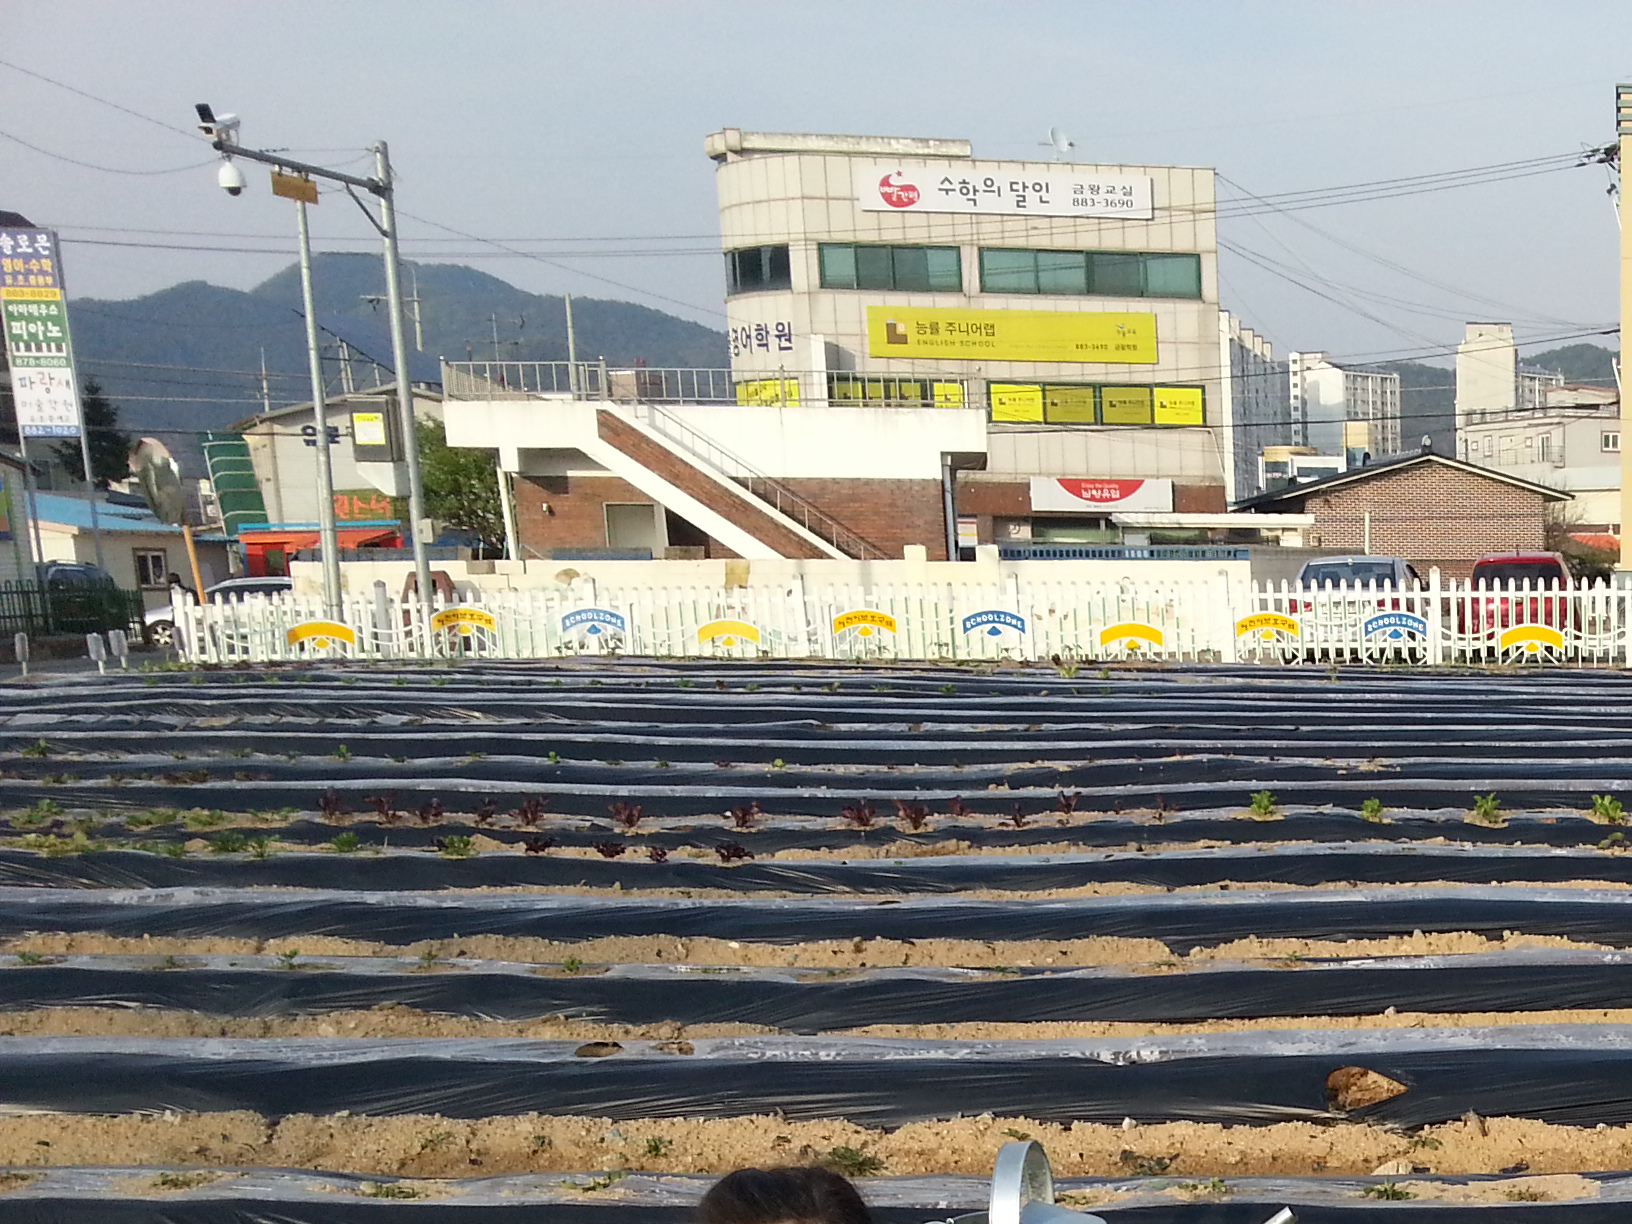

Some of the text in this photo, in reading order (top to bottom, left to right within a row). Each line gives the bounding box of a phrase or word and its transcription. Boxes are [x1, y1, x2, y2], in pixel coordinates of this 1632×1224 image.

[938, 176, 1050, 209] 수학의 달인
[1072, 183, 1134, 197] 금왕교실
[1072, 198, 1134, 209] 883-3690
[0, 233, 51, 255] 솔로몬
[10, 320, 63, 340] 피아노
[915, 321, 996, 337] 능률 주니어랩
[917, 339, 996, 348] ENGLISH SCHOOL
[18, 371, 72, 394] 파랑새
[23, 426, 77, 435] 882-1020
